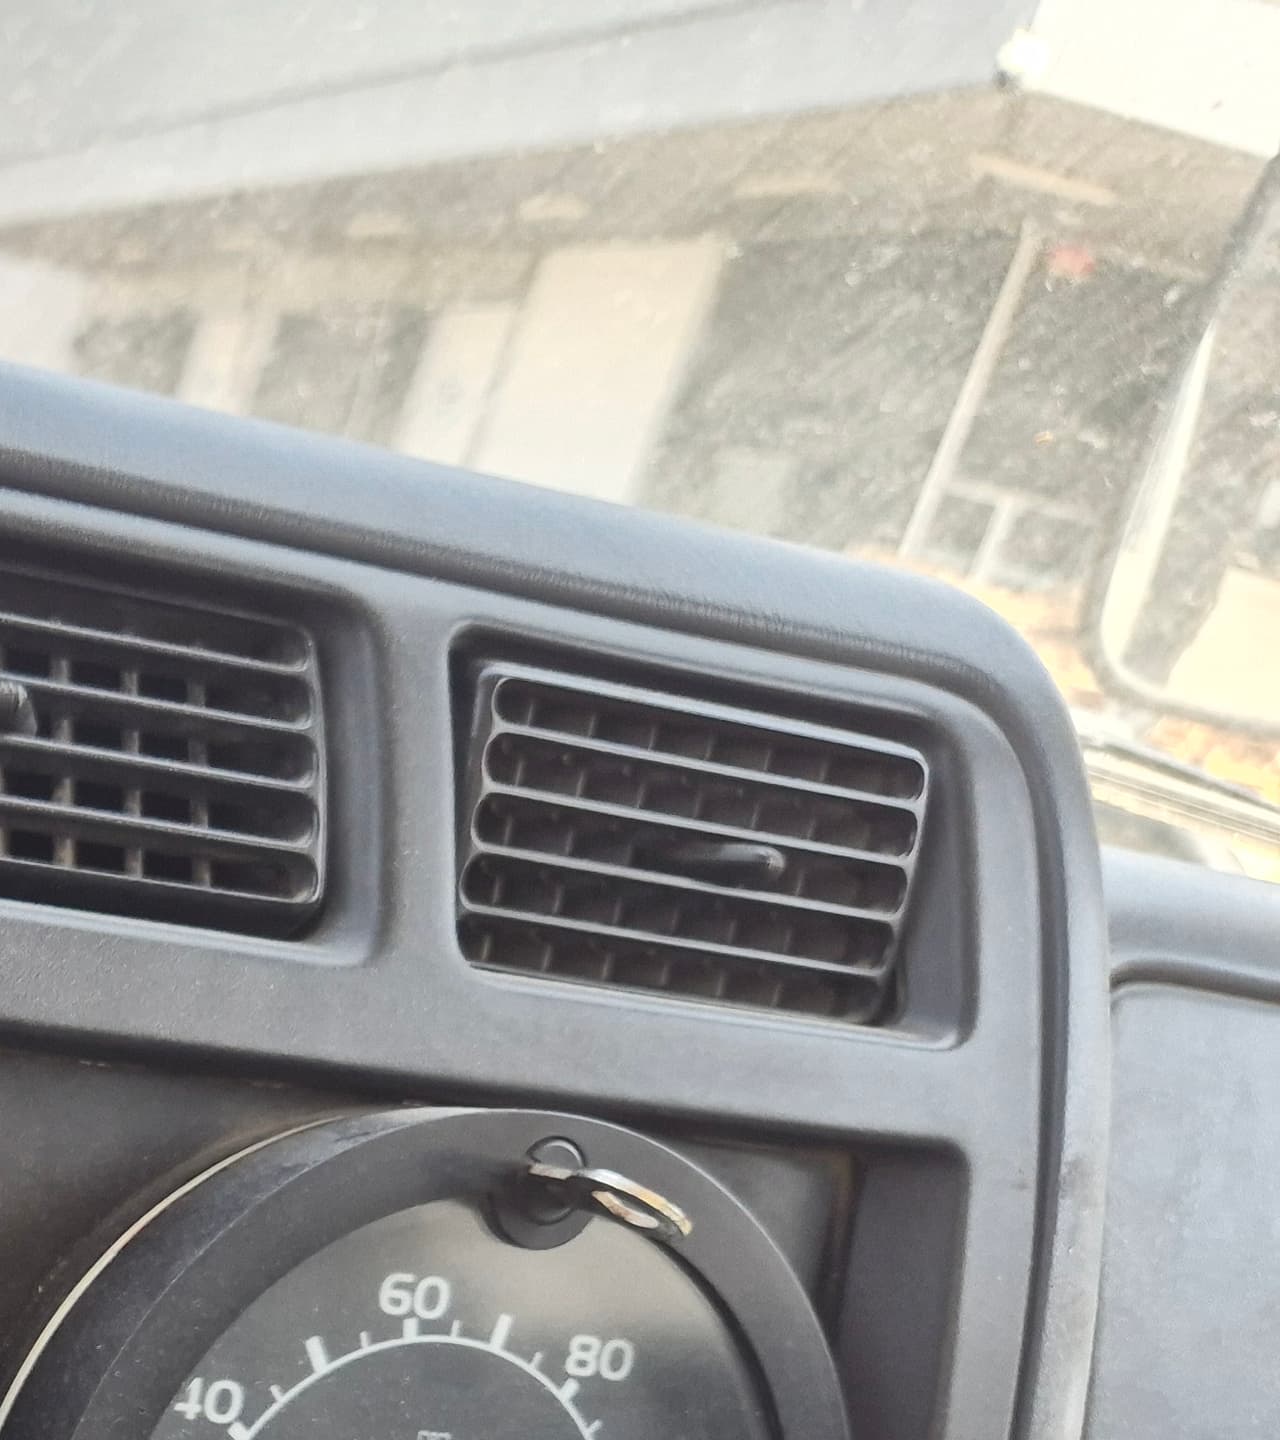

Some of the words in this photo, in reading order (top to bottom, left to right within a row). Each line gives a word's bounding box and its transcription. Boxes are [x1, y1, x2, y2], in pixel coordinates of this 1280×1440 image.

[378, 1272, 451, 1319] 60
[566, 1335, 635, 1382] 80
[174, 1376, 245, 1424] 40
